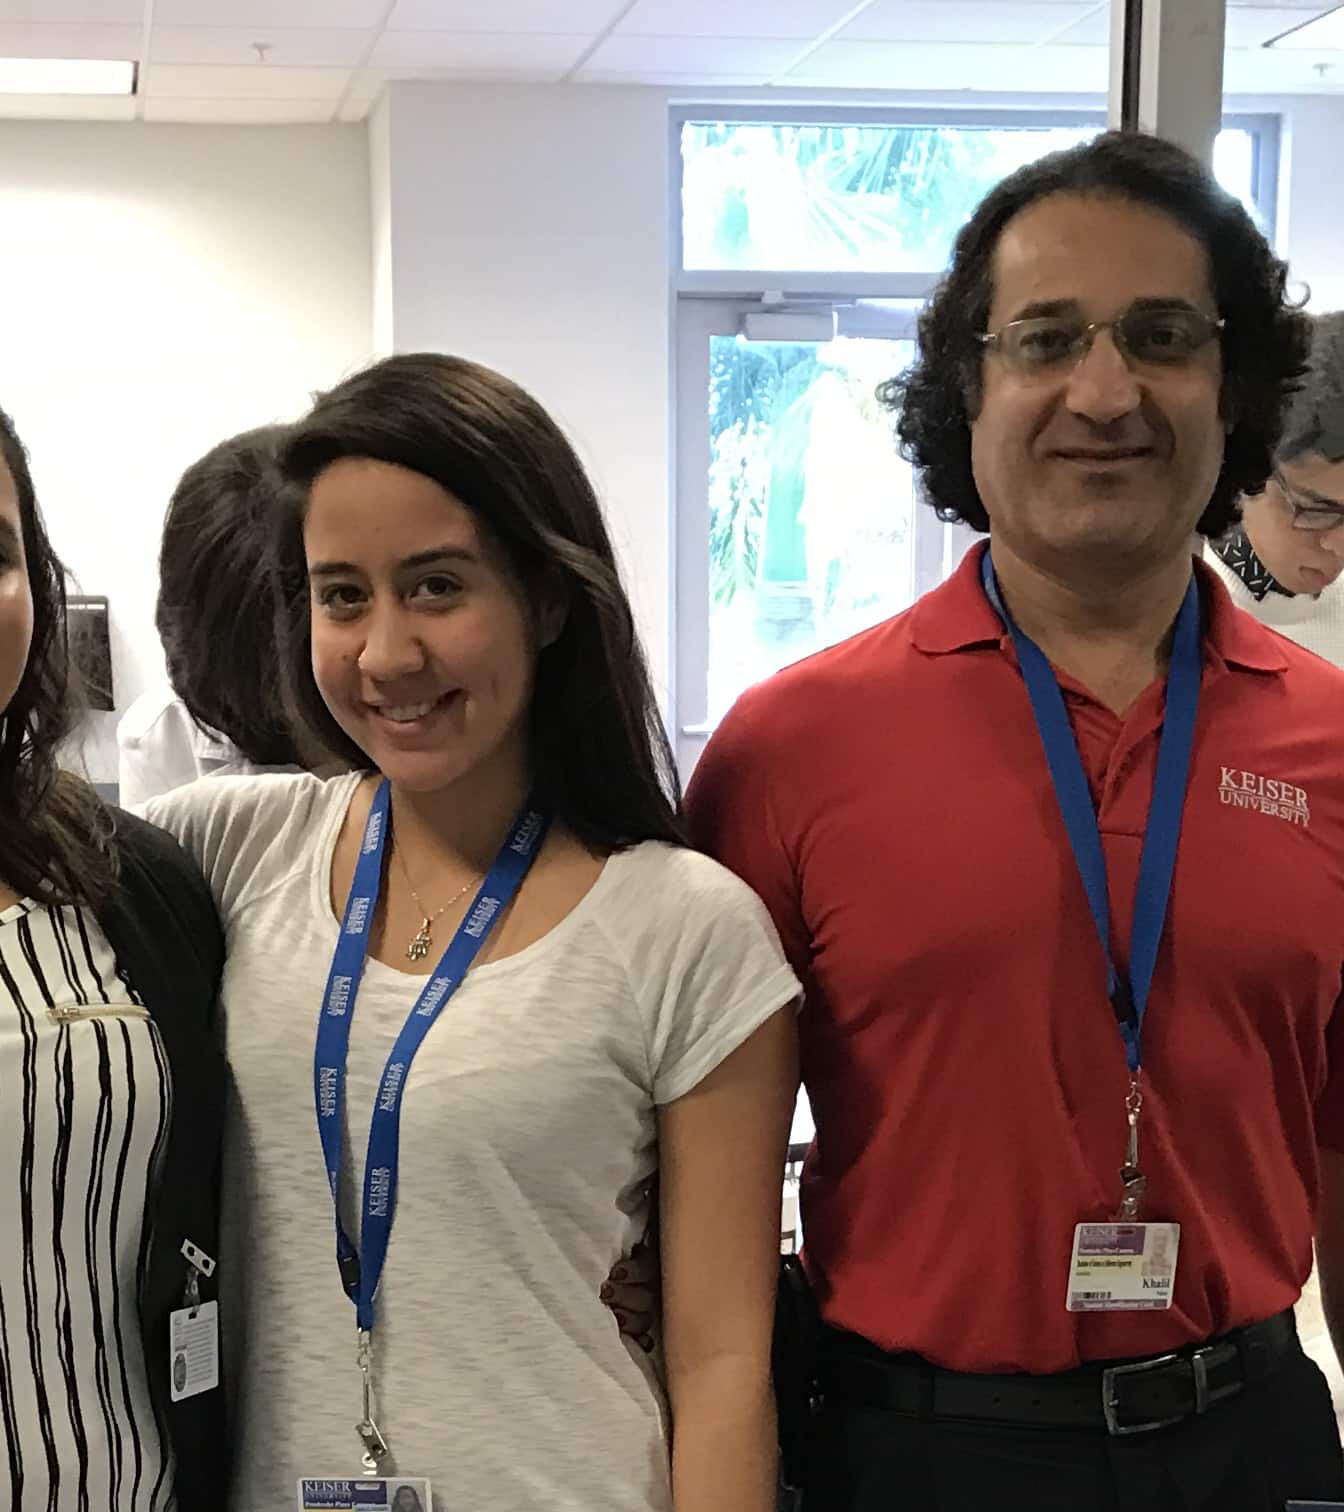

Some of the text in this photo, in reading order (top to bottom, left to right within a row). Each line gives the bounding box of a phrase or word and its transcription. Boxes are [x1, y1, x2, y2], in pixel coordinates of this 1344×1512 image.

[1220, 767, 1308, 808] KEISER
[1218, 790, 1310, 828] UNIVERSITY
[355, 897, 370, 933] KEISER
[336, 976, 353, 1016] KEISER
[327, 1068, 338, 1117] KEISER
[369, 1167, 382, 1216] KEISER
